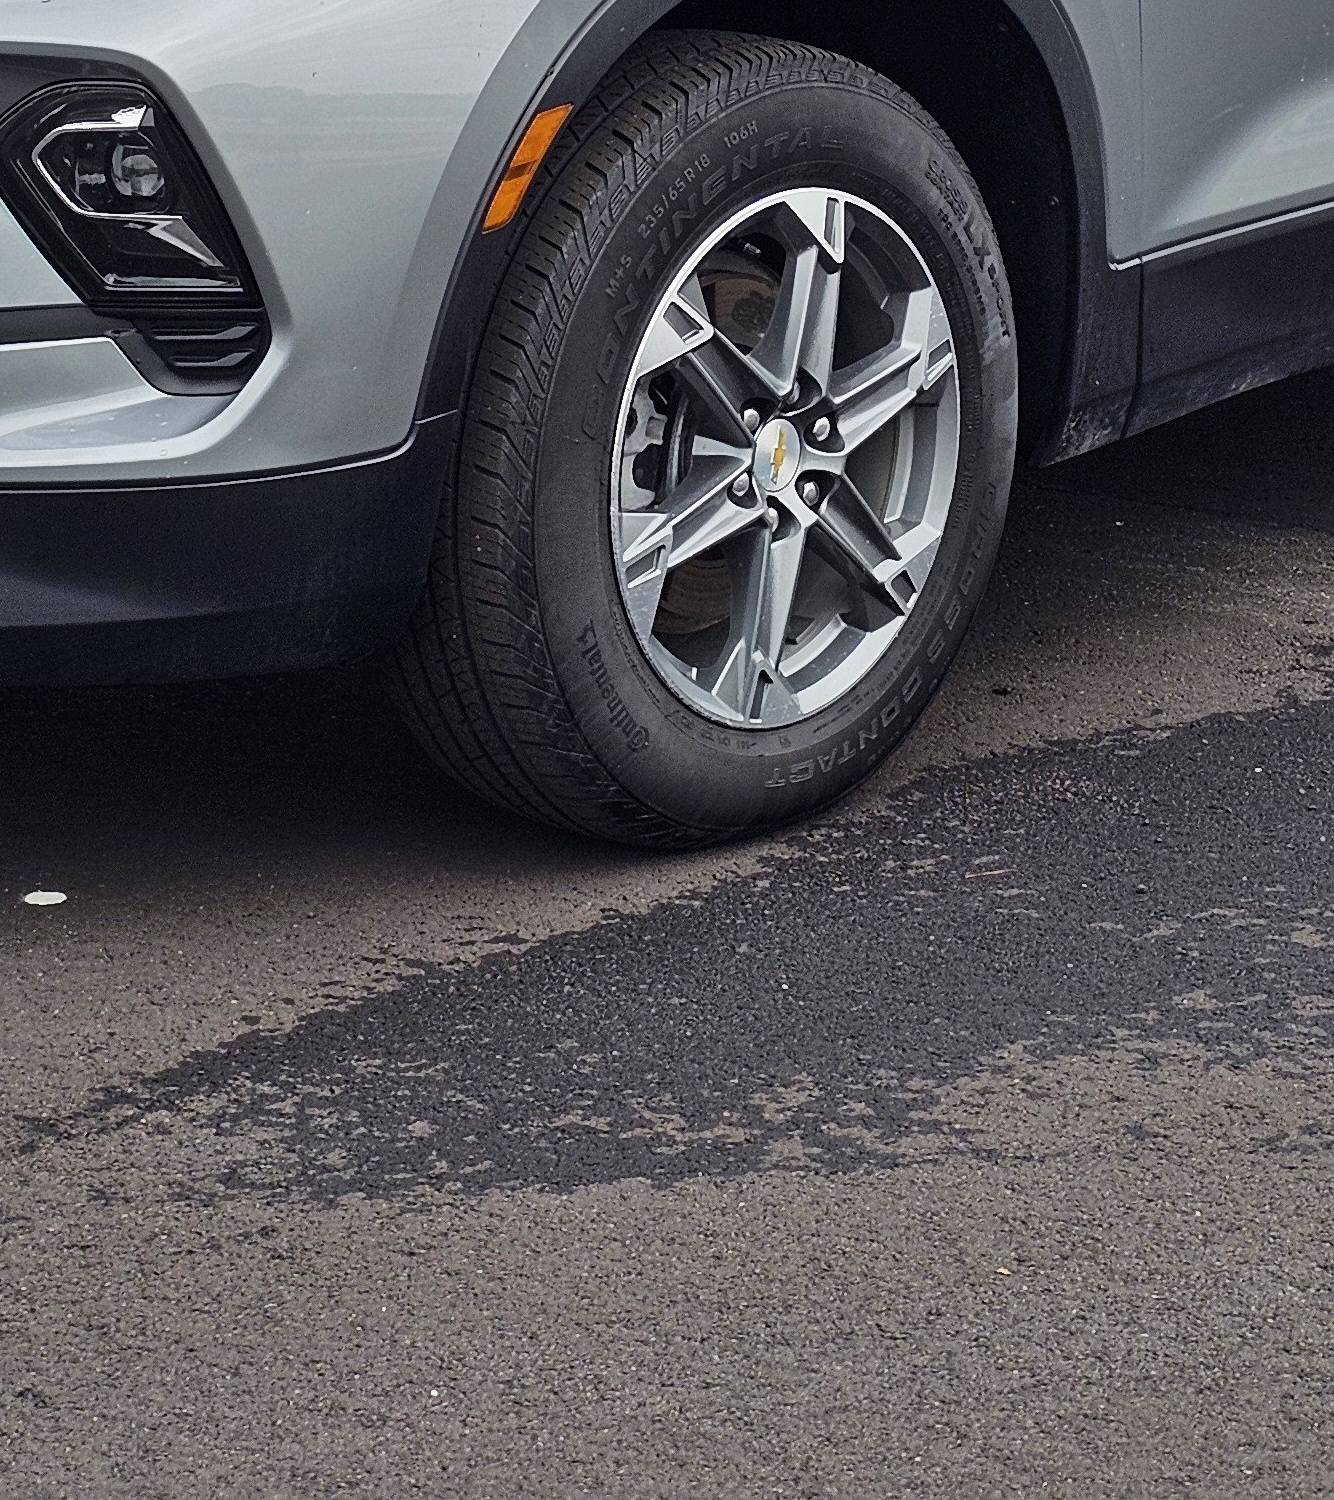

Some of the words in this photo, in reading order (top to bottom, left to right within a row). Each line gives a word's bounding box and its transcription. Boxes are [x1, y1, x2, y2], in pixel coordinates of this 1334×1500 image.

[723, 119, 758, 149] 106H
[581, 125, 843, 435] CONTINENTAL
[604, 250, 632, 299] M+S
[763, 665, 925, 787] CONTACT
